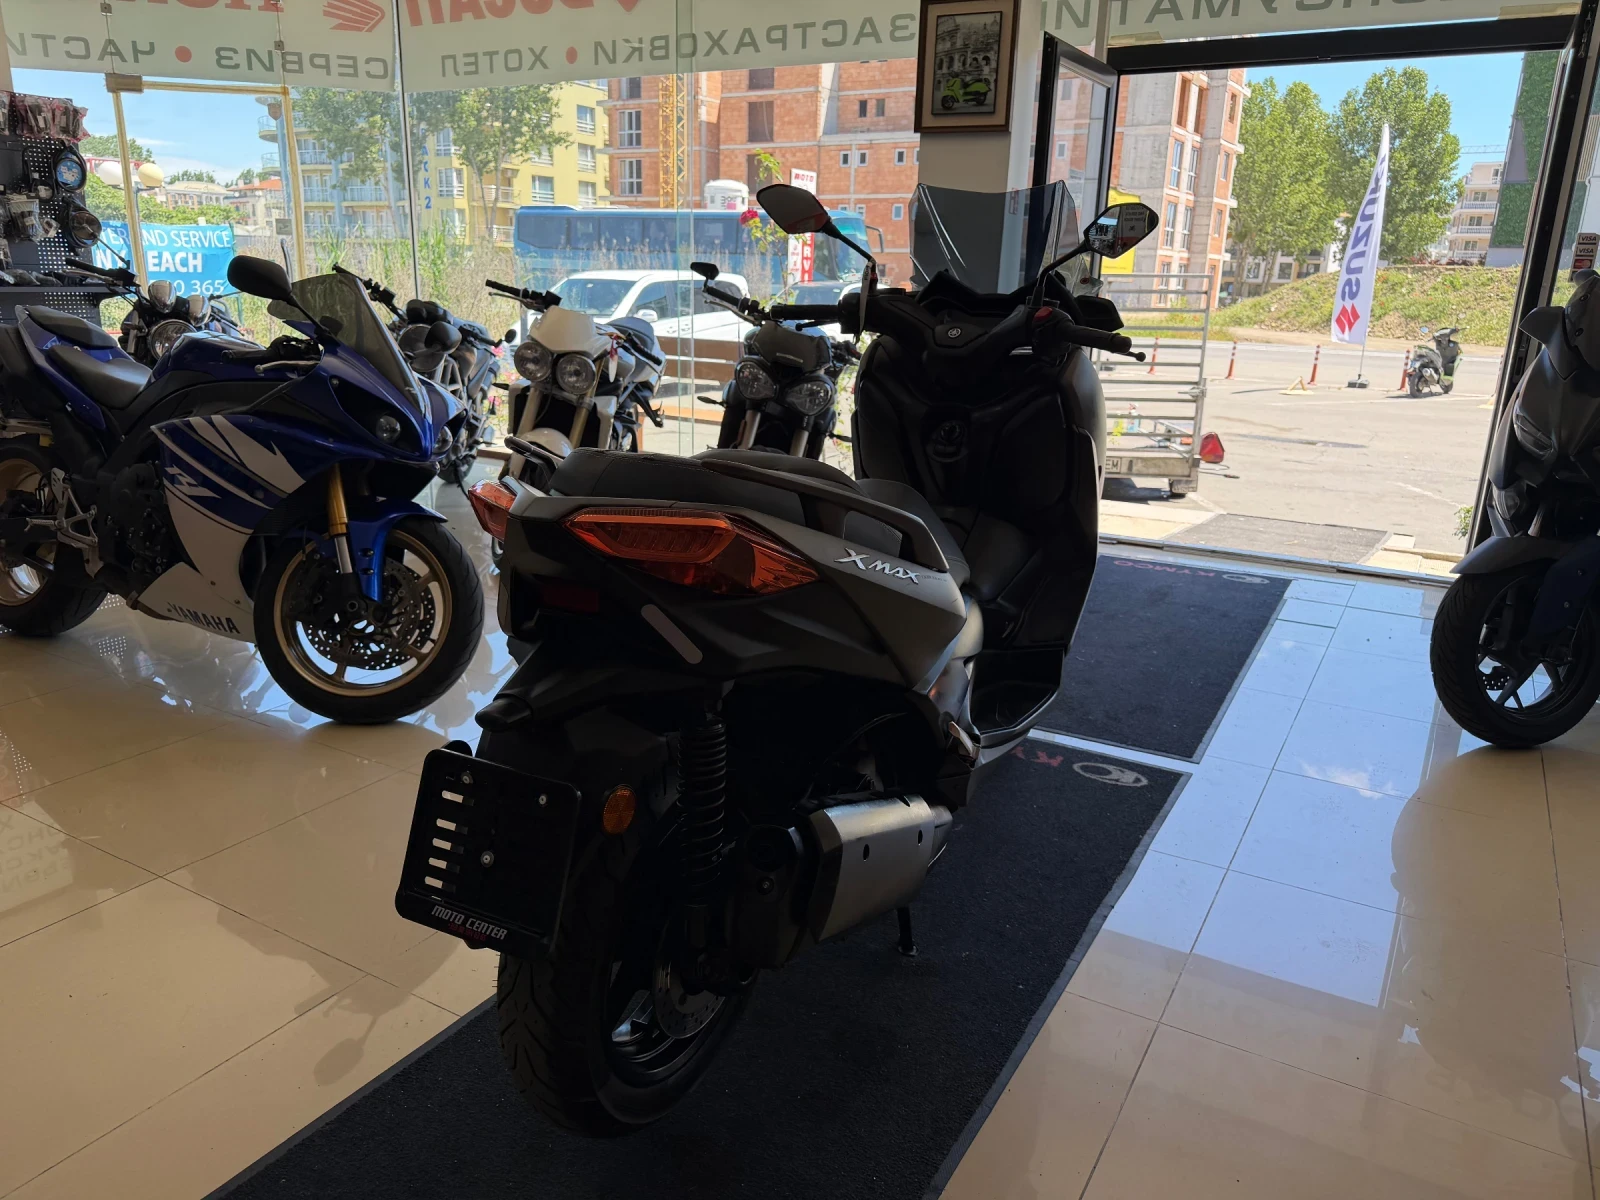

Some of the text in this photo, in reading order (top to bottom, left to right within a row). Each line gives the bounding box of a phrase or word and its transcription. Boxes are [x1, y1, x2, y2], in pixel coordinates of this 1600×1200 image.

[142, 229, 168, 247] ND
[170, 229, 232, 249] SERVICE
[148, 250, 203, 273] EACH
[191, 279, 224, 295] 365
[166, 601, 241, 634] YAMAHA
[431, 904, 465, 925] MOTO
[466, 917, 508, 940] CENTER
